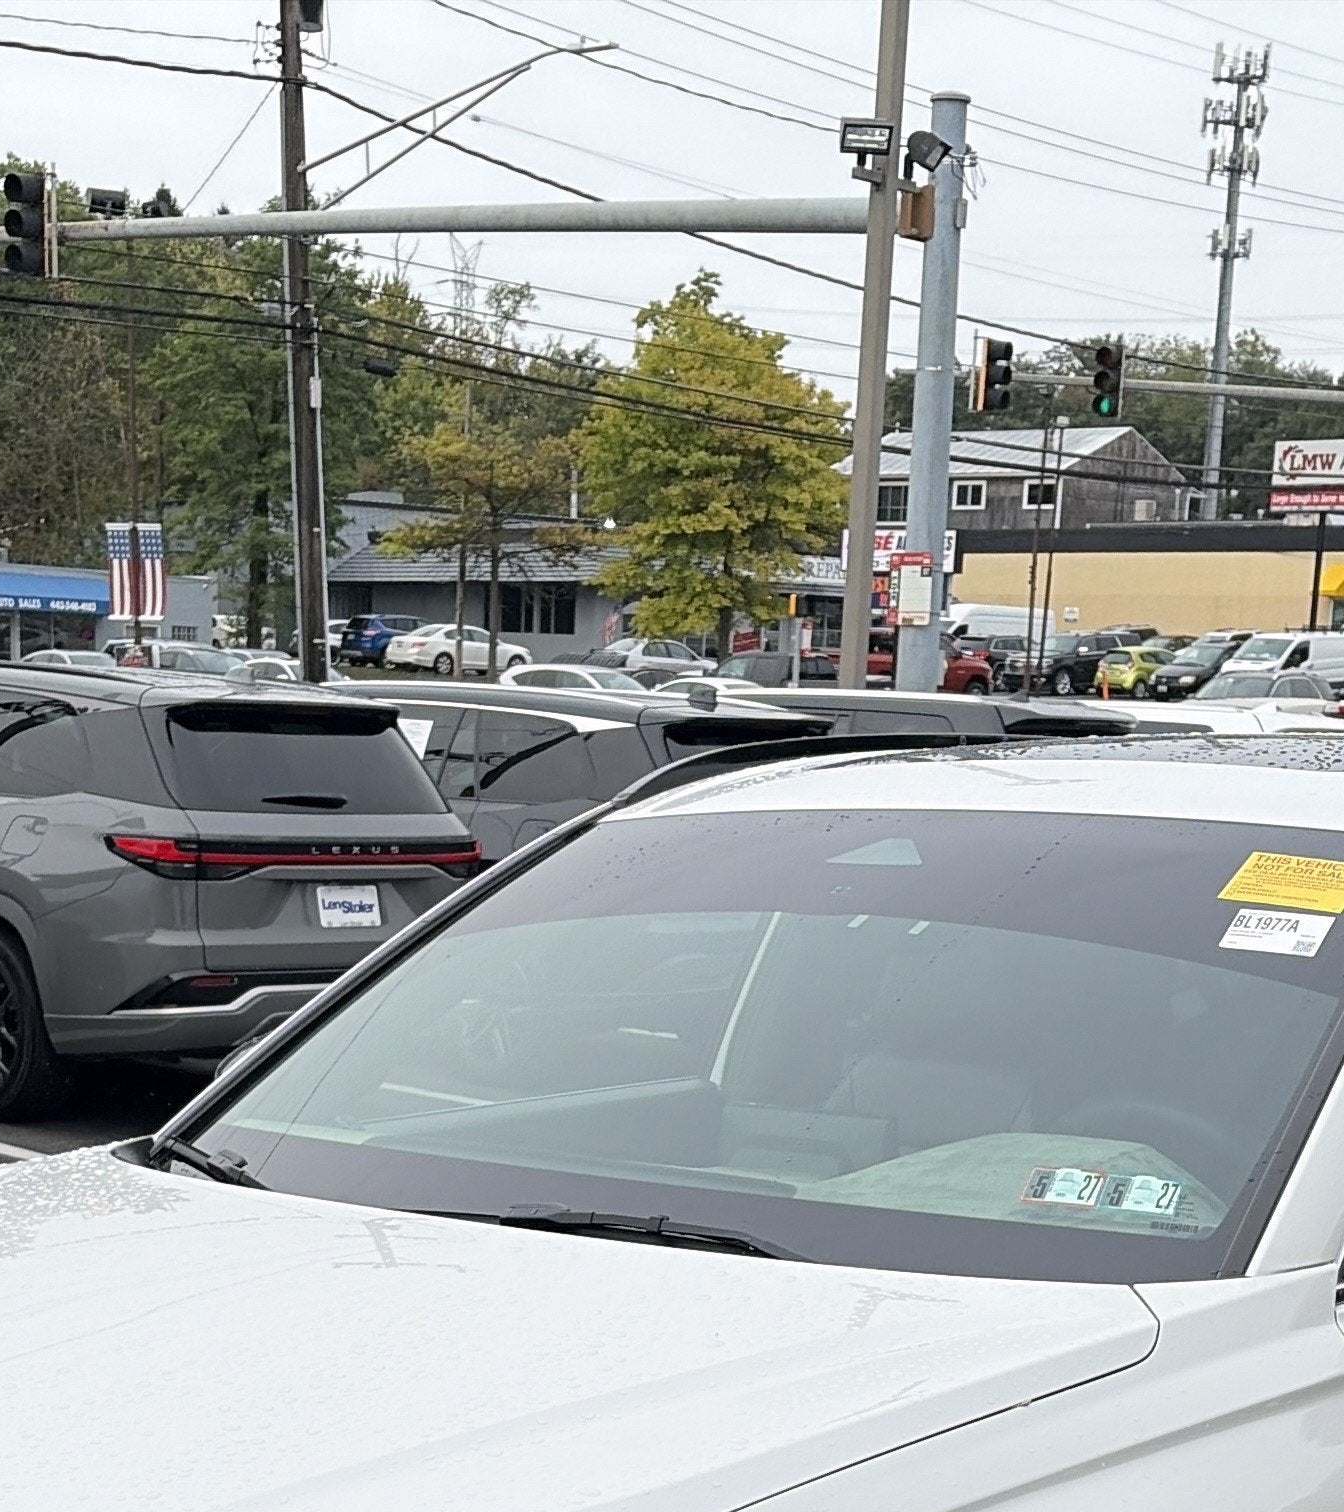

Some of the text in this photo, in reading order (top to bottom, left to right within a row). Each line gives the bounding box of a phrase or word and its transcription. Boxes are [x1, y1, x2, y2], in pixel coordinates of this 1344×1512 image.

[1289, 453, 1337, 471] LMW
[18, 597, 42, 608] SALES
[311, 846, 400, 855] LEXUS
[1256, 854, 1292, 866] THIS
[1253, 862, 1284, 873] NOT
[1284, 866, 1315, 876] FOR
[1233, 914, 1301, 934] BL1977A
[1076, 1174, 1102, 1204] 27
[1155, 1182, 1180, 1210] 27
